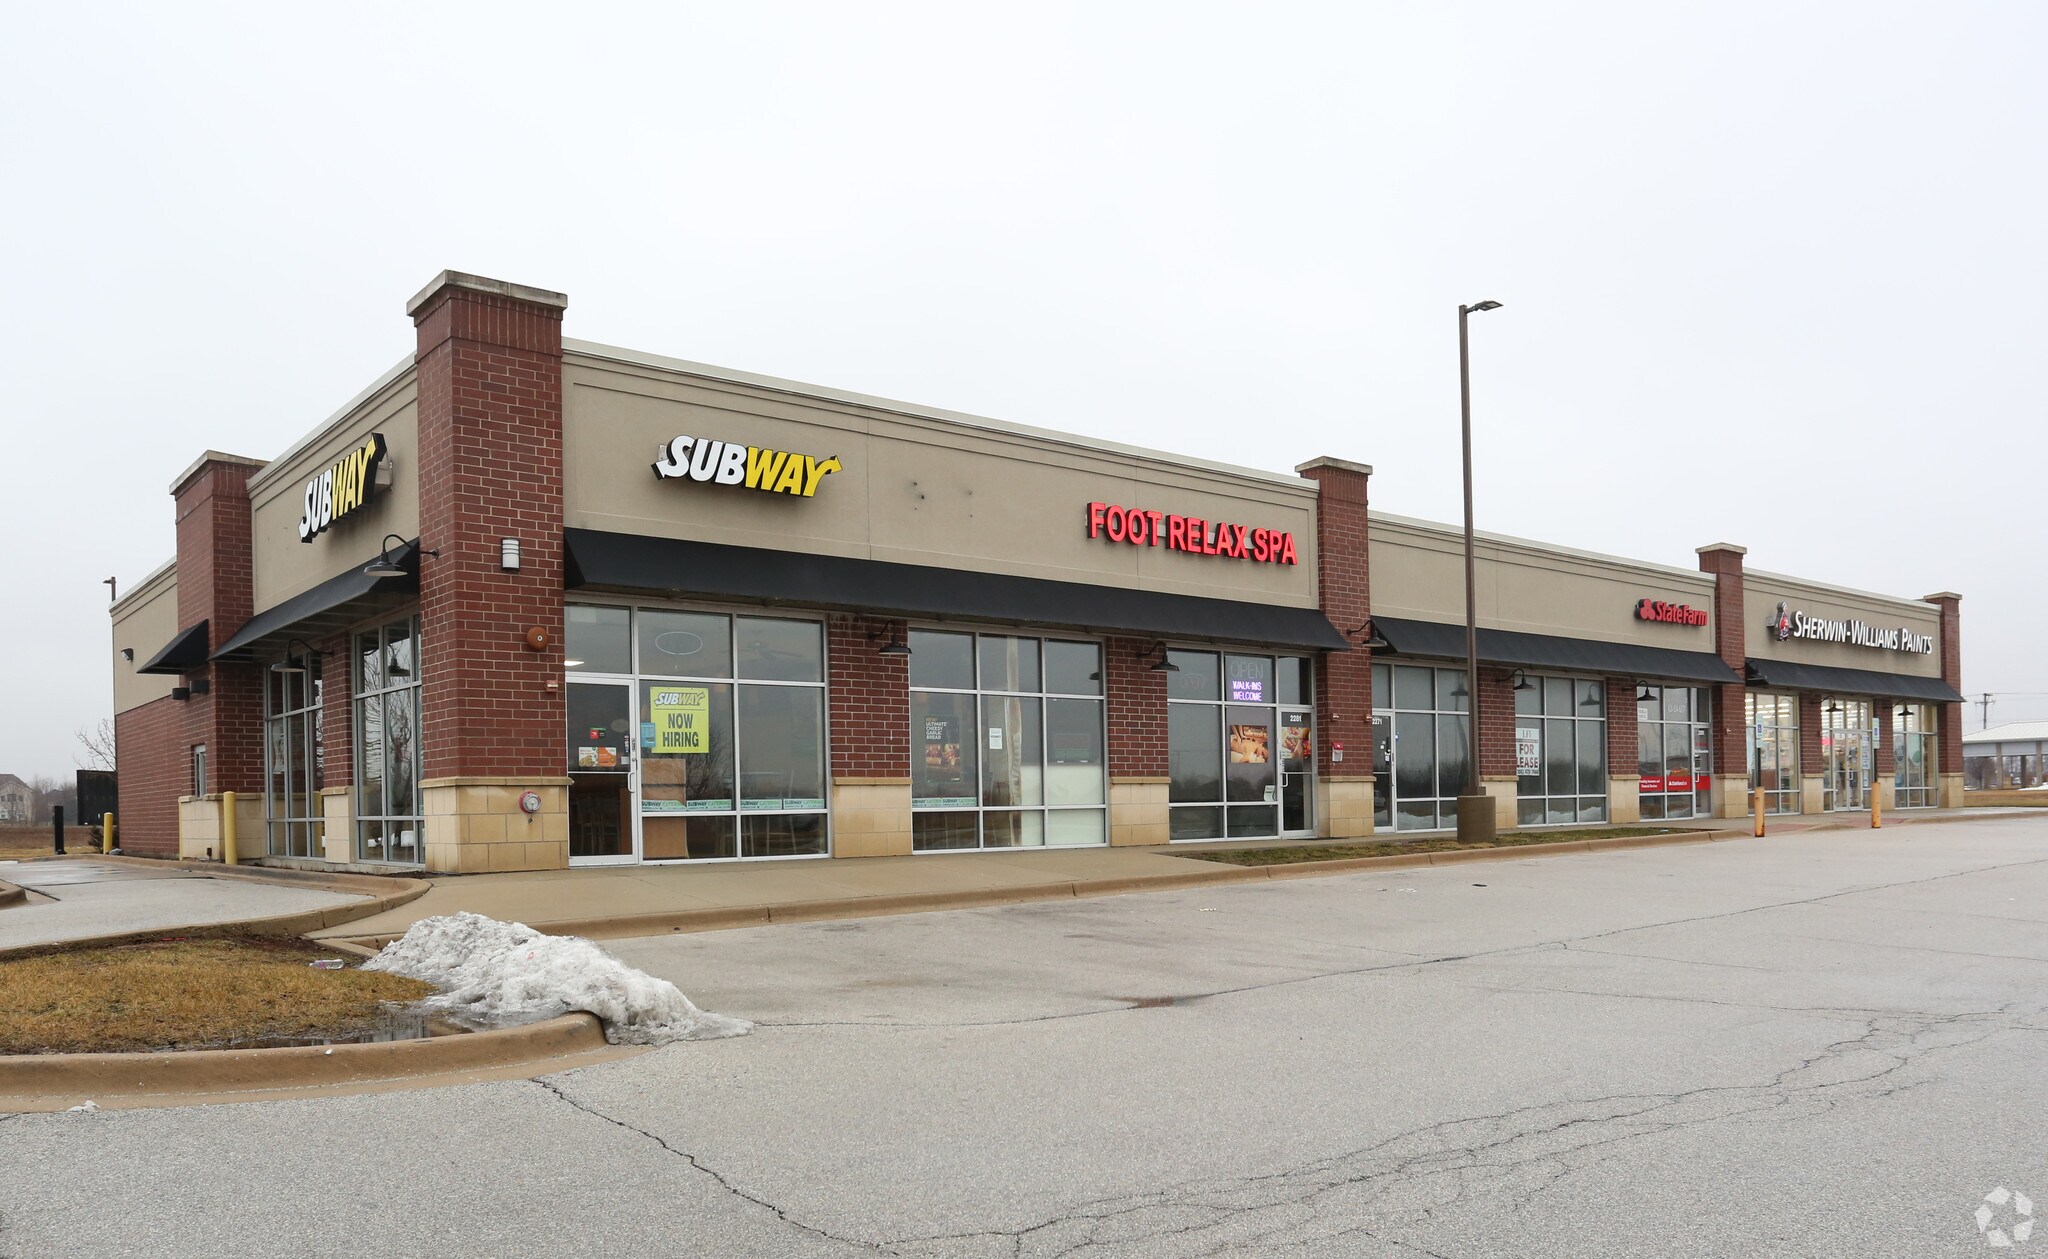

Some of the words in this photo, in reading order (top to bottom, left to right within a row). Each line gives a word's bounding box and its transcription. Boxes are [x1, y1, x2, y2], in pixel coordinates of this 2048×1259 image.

[656, 435, 843, 497] SUBWAY
[298, 435, 376, 539] SUBWAY
[1088, 502, 1162, 546] FOOT
[1167, 514, 1249, 559] RELAX
[1253, 527, 1298, 565] SPA
[1656, 601, 1682, 623] State
[1683, 605, 1707, 626] Farm
[1793, 610, 1898, 650] SHERWIN-WILLIAMS
[1901, 628, 1933, 655] PAINTS
[1230, 661, 1263, 679] OPEN
[1232, 680, 1262, 691] WALK-INS
[654, 691, 705, 706] SUBWAY
[1233, 691, 1262, 701] WELCOME
[668, 713, 693, 729] NOW
[662, 731, 699, 747] HIRING
[1519, 743, 1535, 755] FOR
